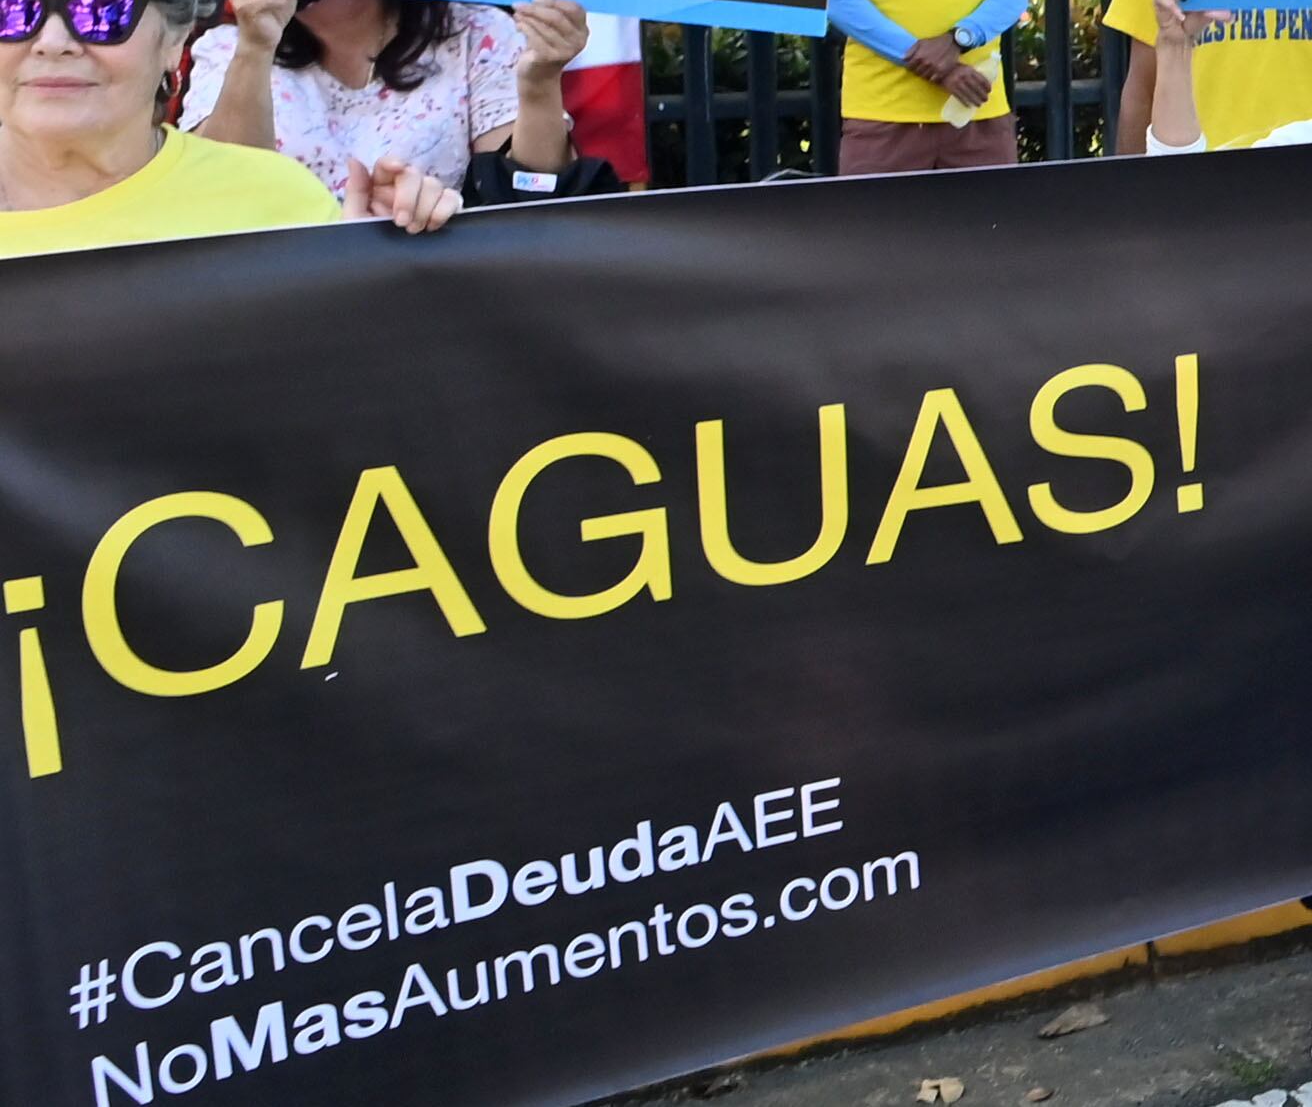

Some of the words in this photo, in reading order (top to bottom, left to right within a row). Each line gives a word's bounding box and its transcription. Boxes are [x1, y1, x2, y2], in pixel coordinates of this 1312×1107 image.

[5, 355, 1206, 778] ¡CAGUAS!
[69, 778, 843, 1030] #CancelaDeudaAEE
[91, 849, 920, 1107] NoMasAumentos.com
